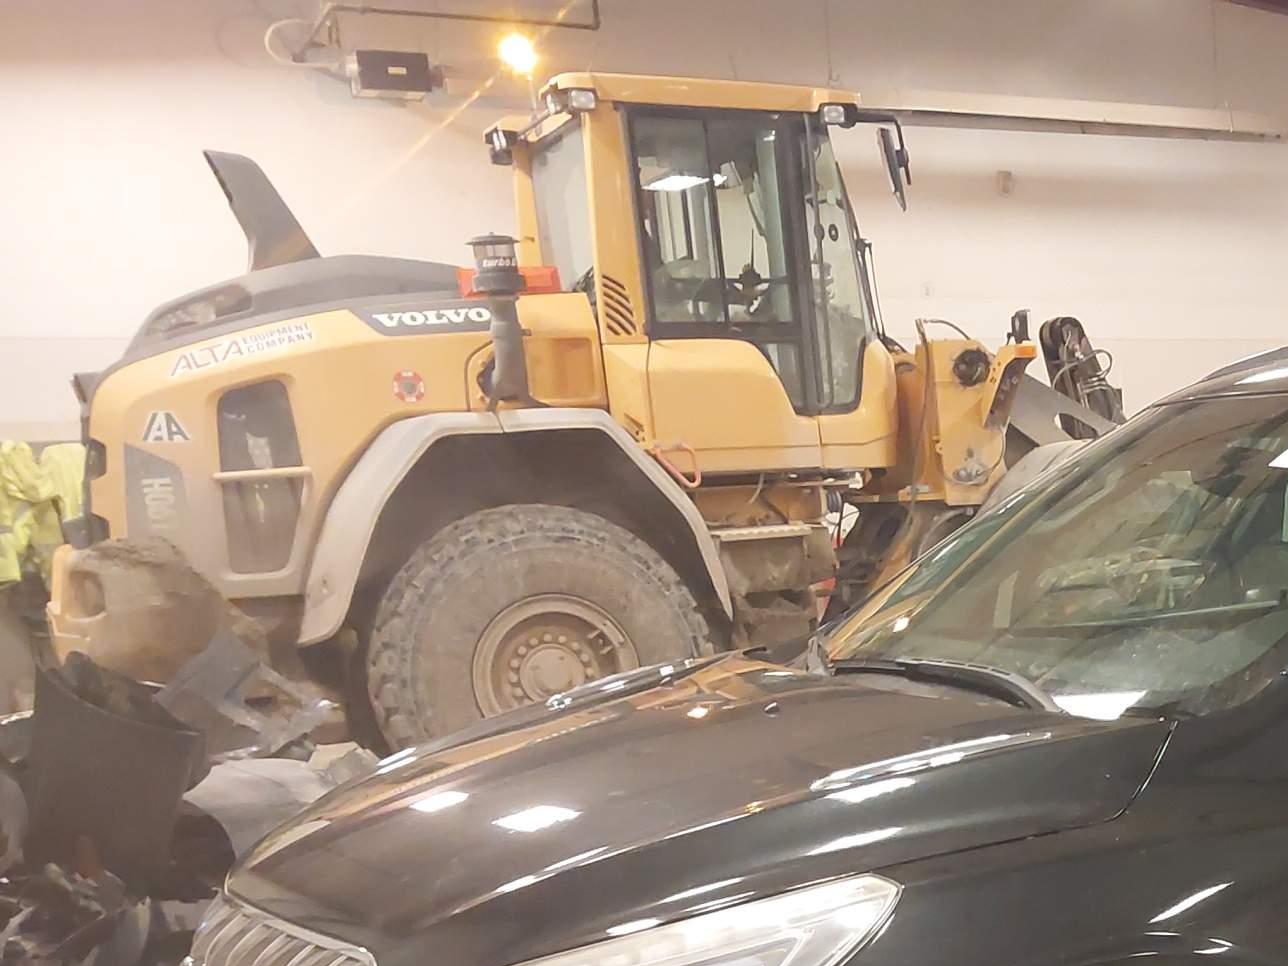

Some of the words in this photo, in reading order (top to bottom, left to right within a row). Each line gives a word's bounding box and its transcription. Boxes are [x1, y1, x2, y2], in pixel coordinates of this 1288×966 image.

[373, 307, 492, 328] VOLVO
[241, 322, 310, 345] EQUIPMENT
[246, 332, 313, 354] COMPANY
[170, 339, 245, 376] ALTA
